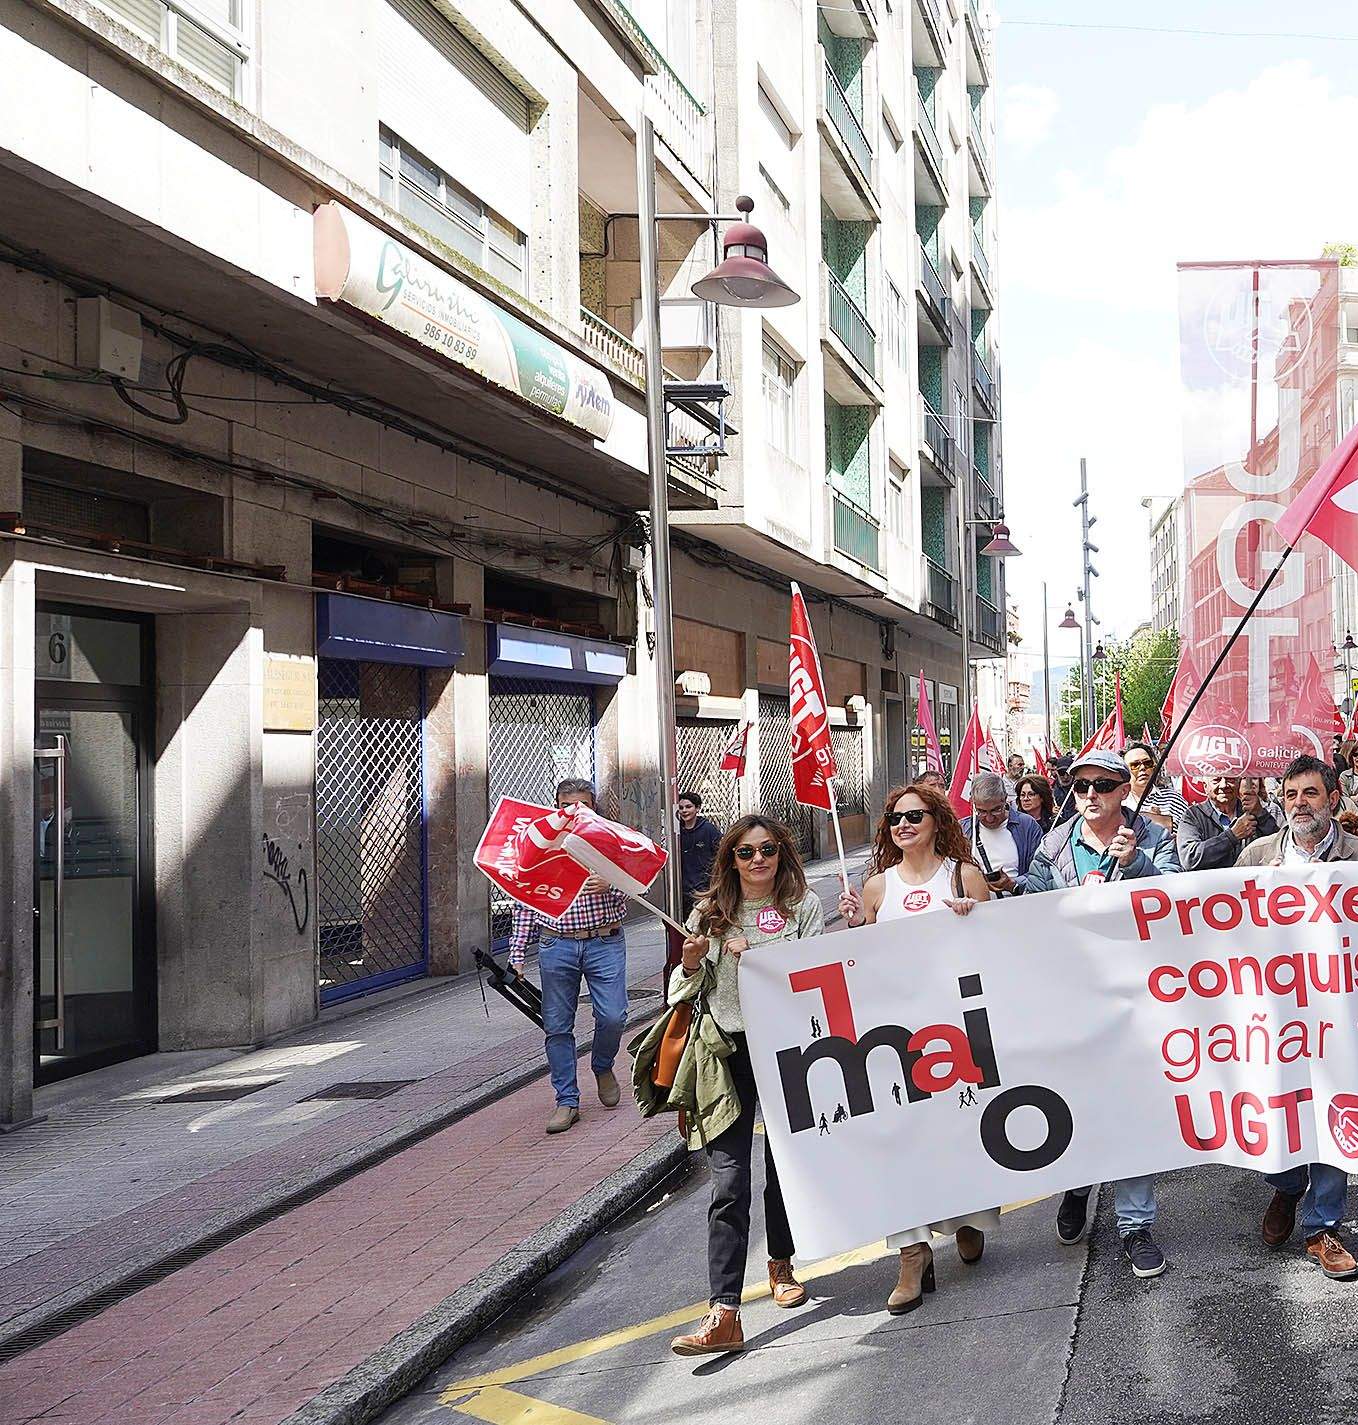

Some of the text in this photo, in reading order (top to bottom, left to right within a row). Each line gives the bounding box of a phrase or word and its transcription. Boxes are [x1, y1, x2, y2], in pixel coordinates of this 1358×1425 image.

[423, 322, 478, 361] 986 10 83 89
[48, 632, 67, 664] 6
[1189, 735, 1242, 757] UGT
[1257, 746, 1302, 759] Galicia
[1161, 1012, 1335, 1084] gañar
[1174, 1087, 1314, 1158] UGT
